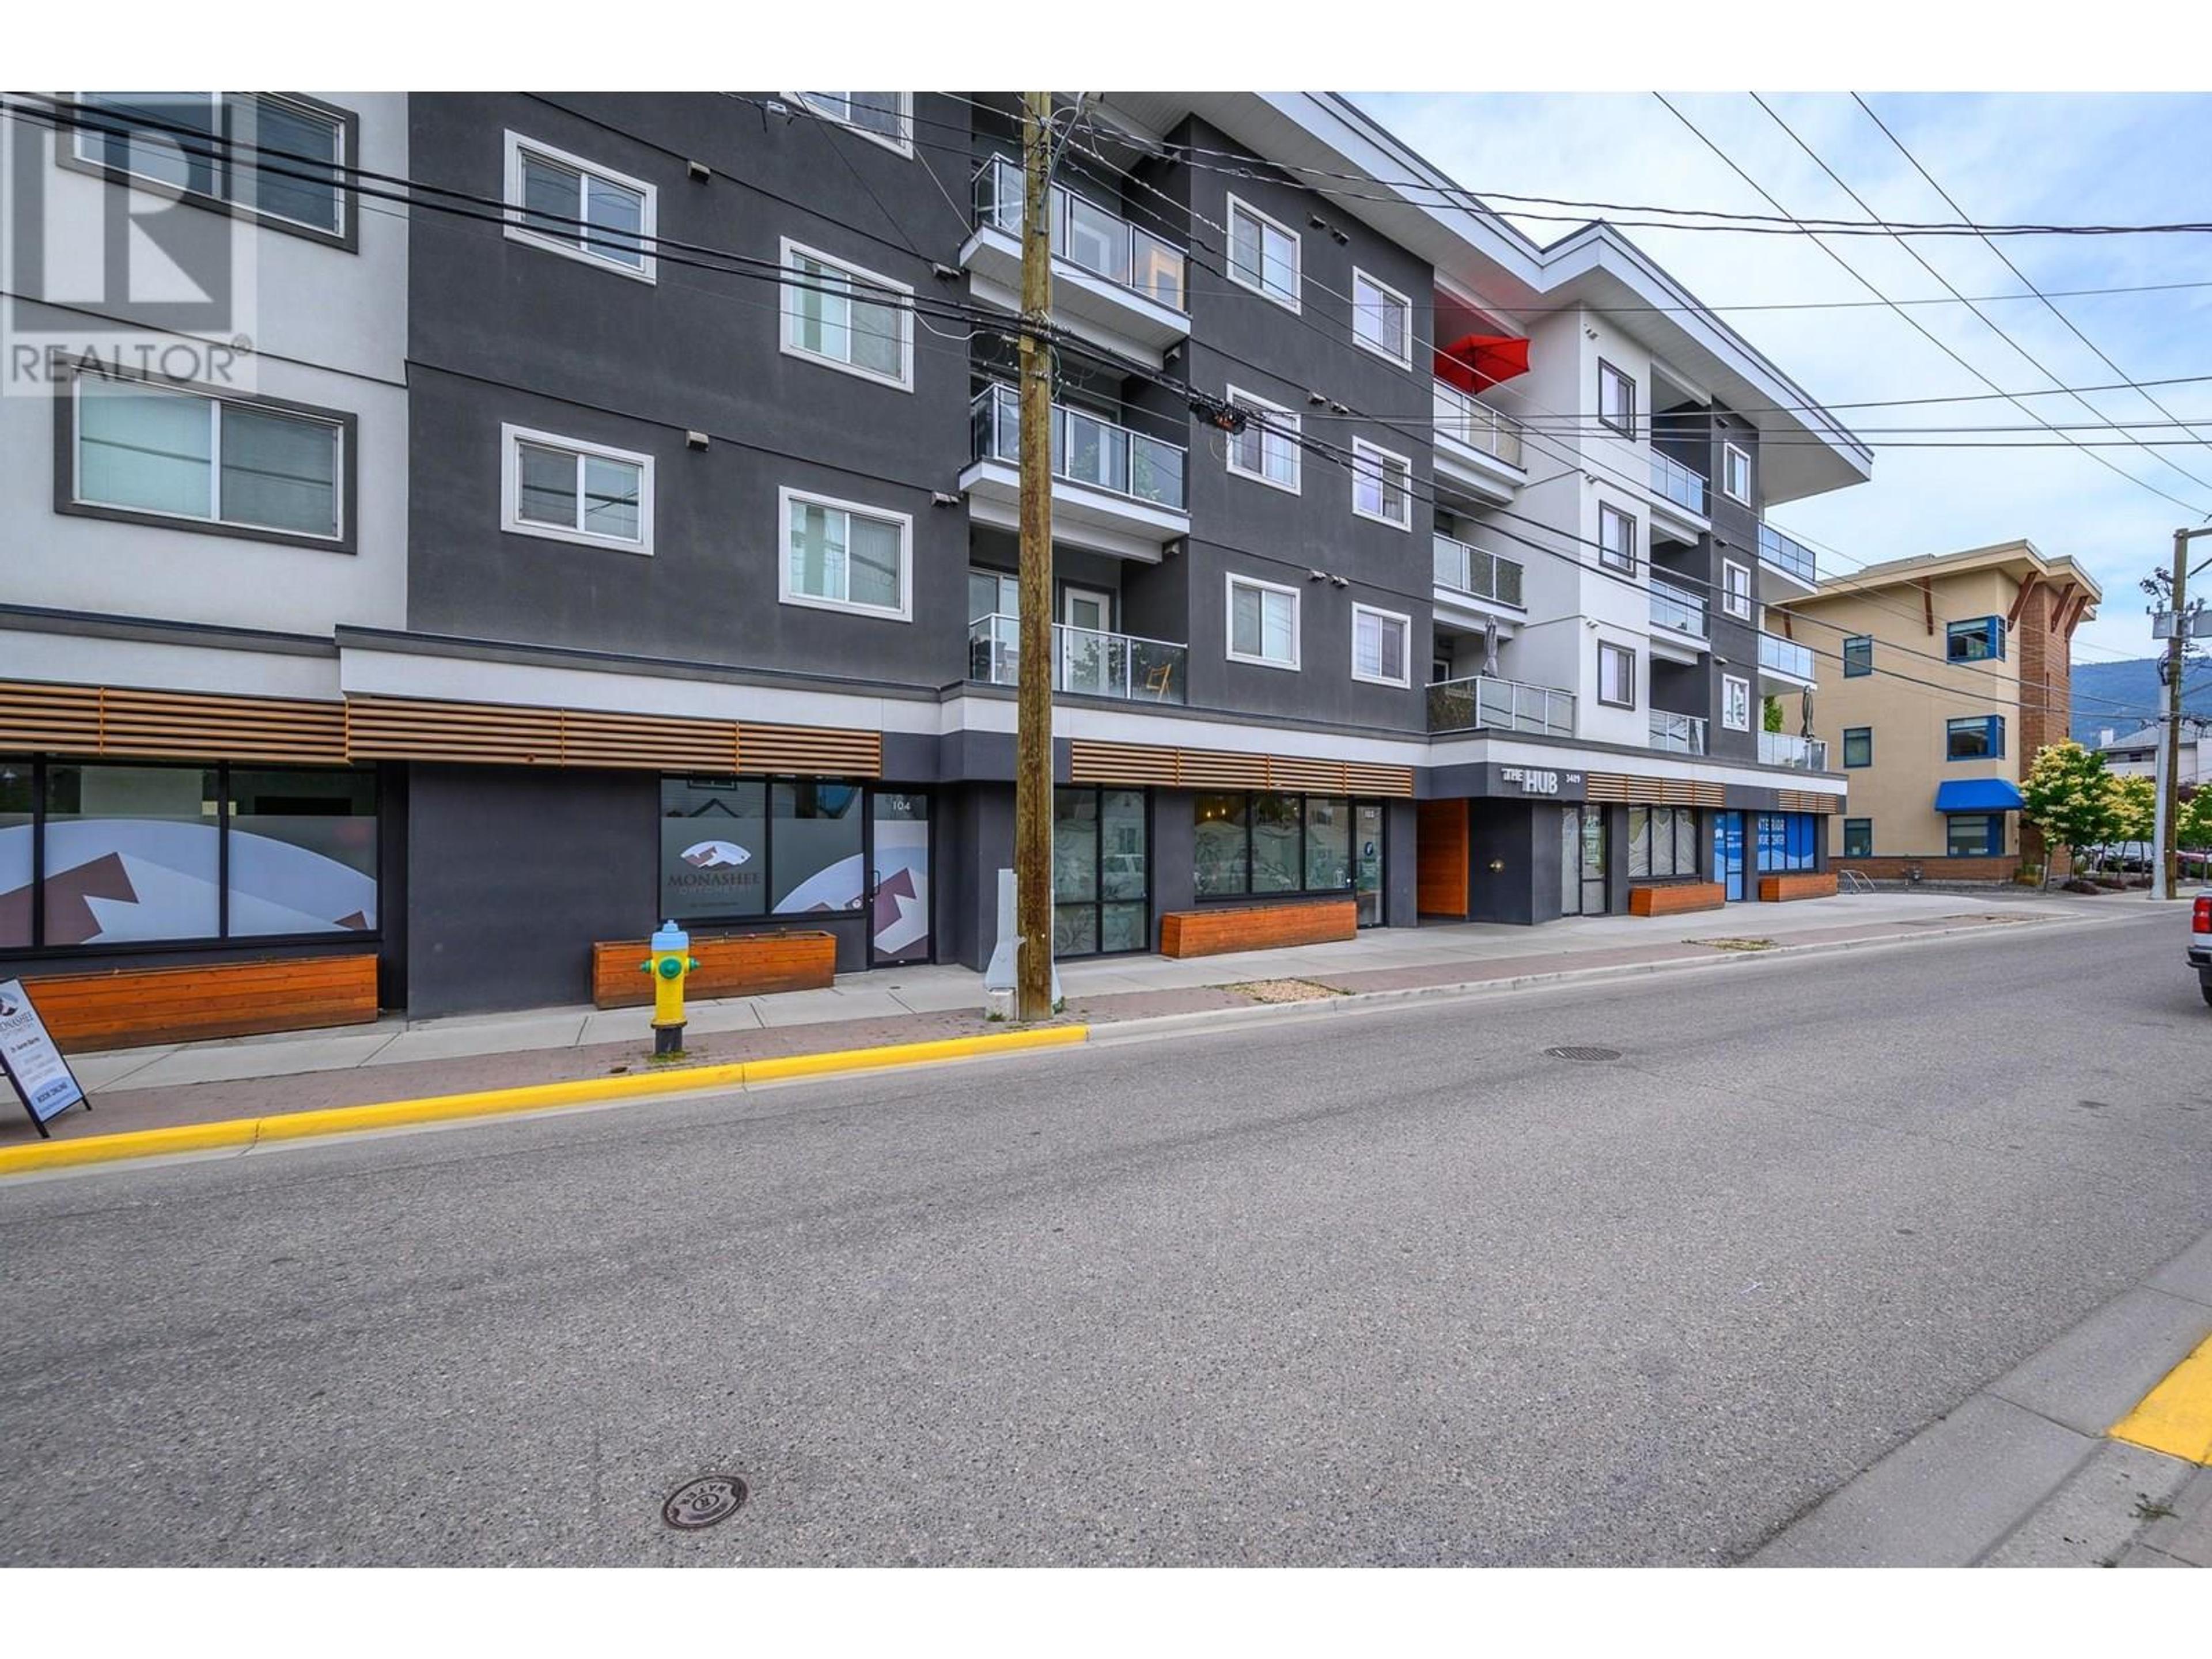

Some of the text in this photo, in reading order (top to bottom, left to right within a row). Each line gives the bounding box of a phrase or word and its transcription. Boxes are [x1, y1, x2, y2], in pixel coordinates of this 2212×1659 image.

[1501, 767, 1558, 794] THE HUB
[892, 801, 911, 810] 104
[667, 872, 761, 886] MONASHEE
[0, 1011, 34, 1032] ONASHEE
